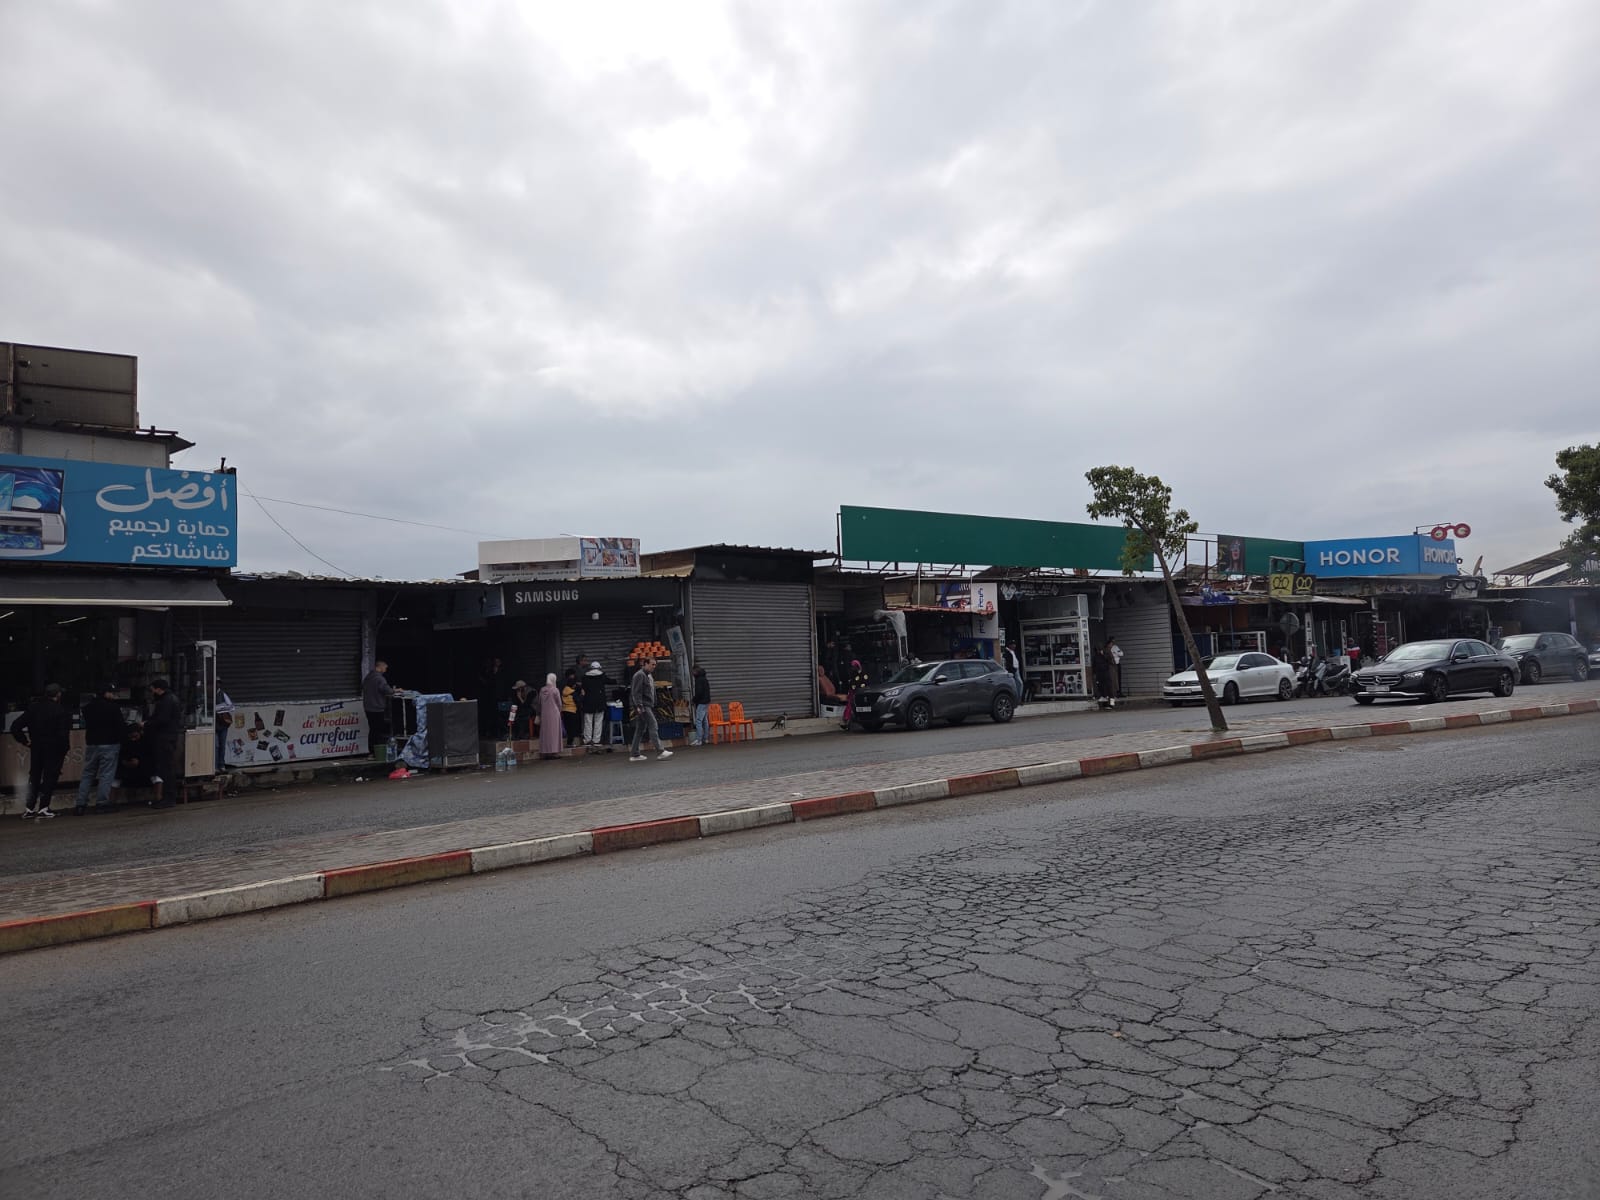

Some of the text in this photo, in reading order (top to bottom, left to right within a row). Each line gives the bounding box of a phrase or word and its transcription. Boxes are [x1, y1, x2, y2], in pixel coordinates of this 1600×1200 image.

[95, 468, 228, 512] أفضل
[108, 518, 230, 539] حماية لجميع
[131, 541, 230, 562] شاشاتكم
[1319, 548, 1400, 566] HONOR
[1423, 546, 1456, 565] HONOR
[515, 589, 579, 604] SAMSUNG
[318, 715, 359, 727] Produits
[300, 727, 361, 746] carrefour
[321, 742, 359, 755] exclusifs
